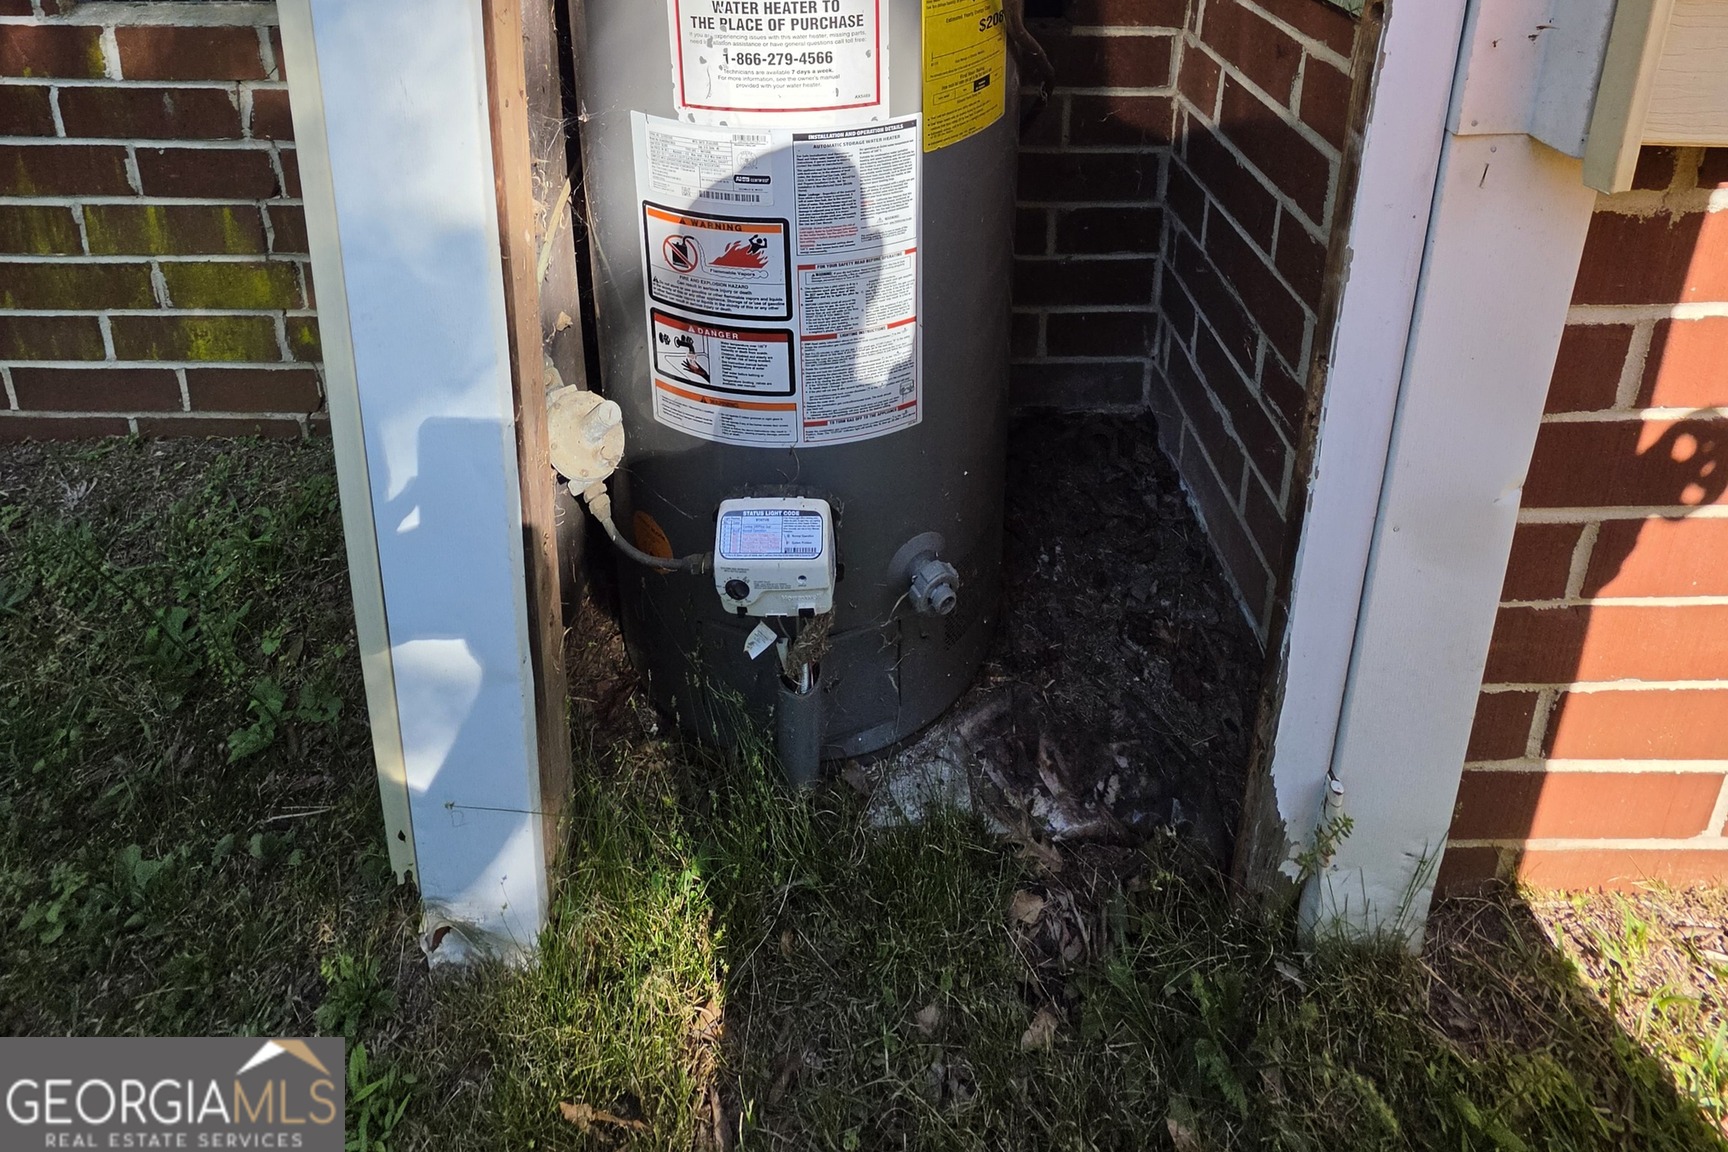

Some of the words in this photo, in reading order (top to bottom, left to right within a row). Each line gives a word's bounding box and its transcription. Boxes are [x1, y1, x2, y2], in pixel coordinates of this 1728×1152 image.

[712, 0, 759, 14] WATER
[764, 1, 817, 14] HEATER
[823, 0, 840, 12] TO
[690, 16, 715, 29] THE
[720, 17, 763, 31] PLACE
[768, 18, 785, 31] OF
[791, 14, 864, 30] PURCHASE
[723, 51, 833, 65] 1-866-279-4566
[808, 132, 845, 140] INSTALLATION
[856, 128, 884, 136] OPERATION
[690, 219, 742, 231] WARNING
[697, 328, 739, 339] DANGER
